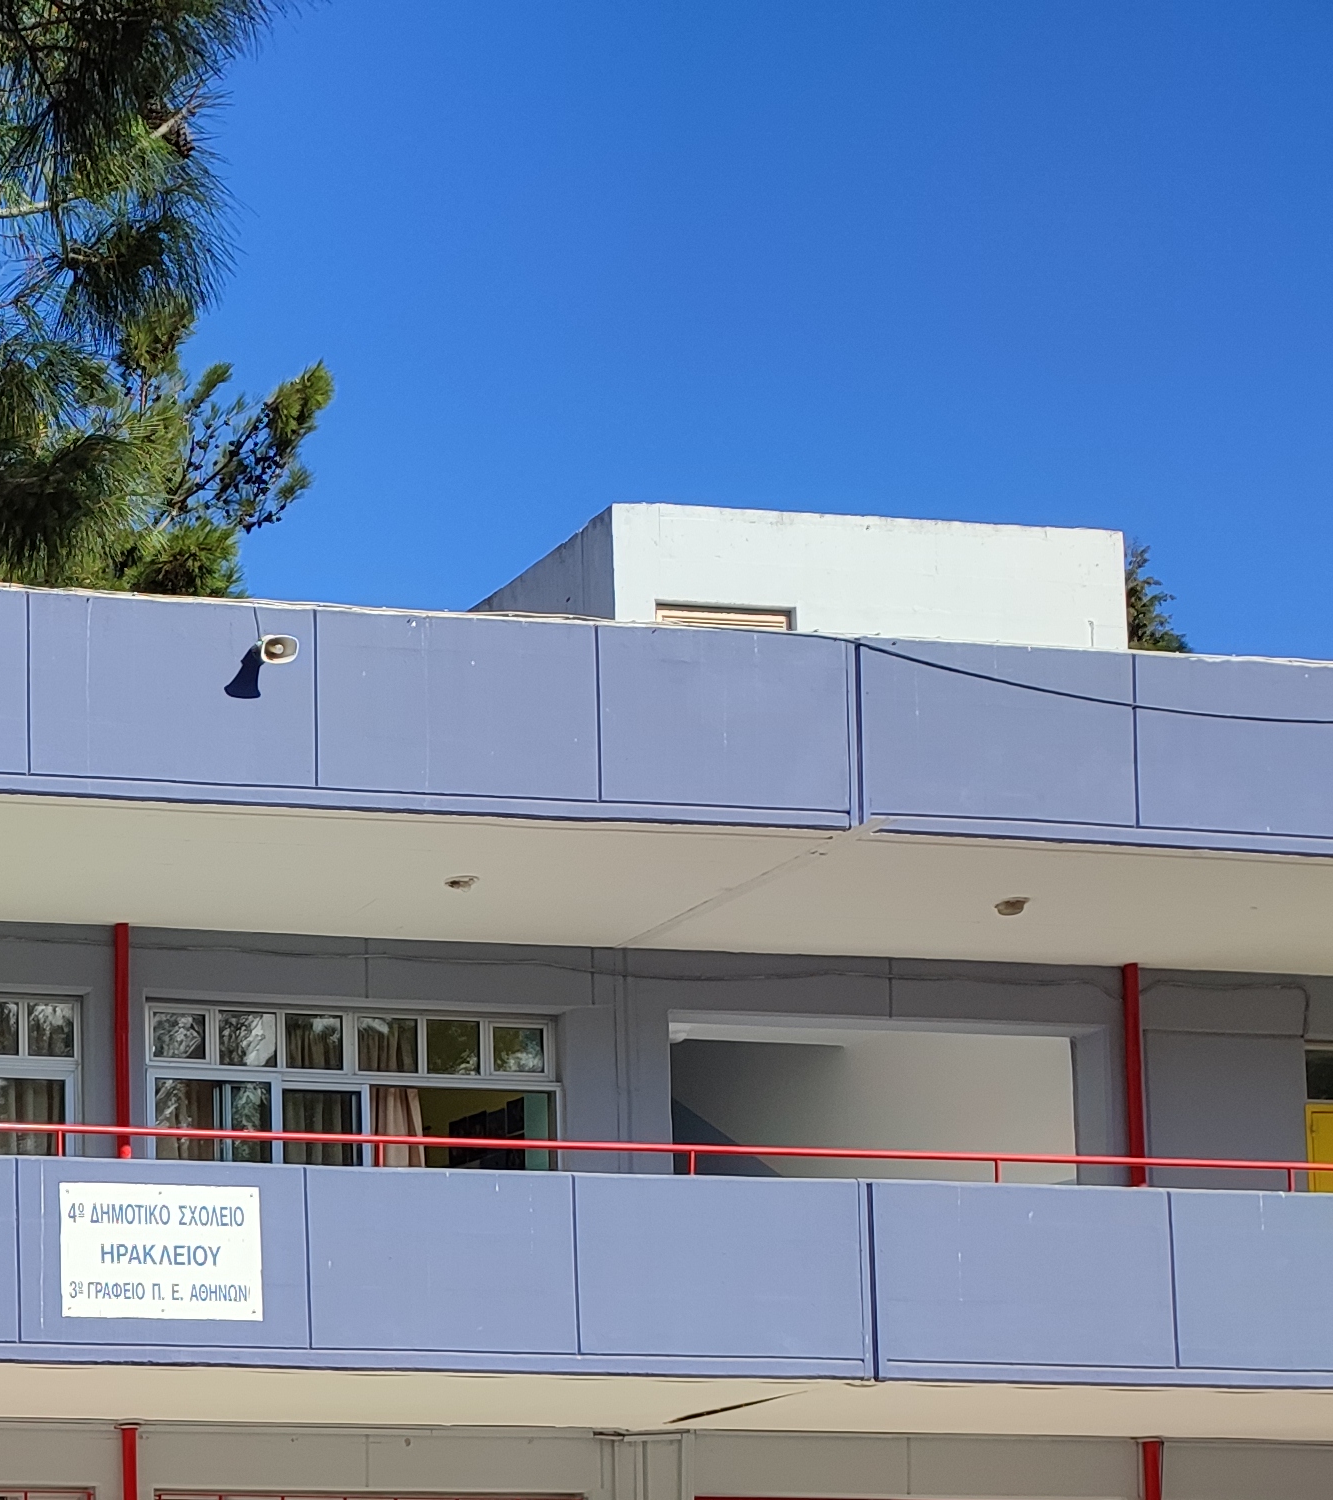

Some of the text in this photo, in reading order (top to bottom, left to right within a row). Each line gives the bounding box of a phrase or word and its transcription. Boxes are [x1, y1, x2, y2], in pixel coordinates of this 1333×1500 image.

[90, 1202, 171, 1225] ΔΗΜΟΤΙΚΟ
[178, 1205, 245, 1227] ΣΧΟΛΕΙΟ
[100, 1243, 221, 1266] ΗΡΑΚΛΕΙΟΥ
[88, 1282, 145, 1300] ΓΡΑΦΕΙΟ
[190, 1284, 248, 1302] ΑΘΗΝΩΝ
